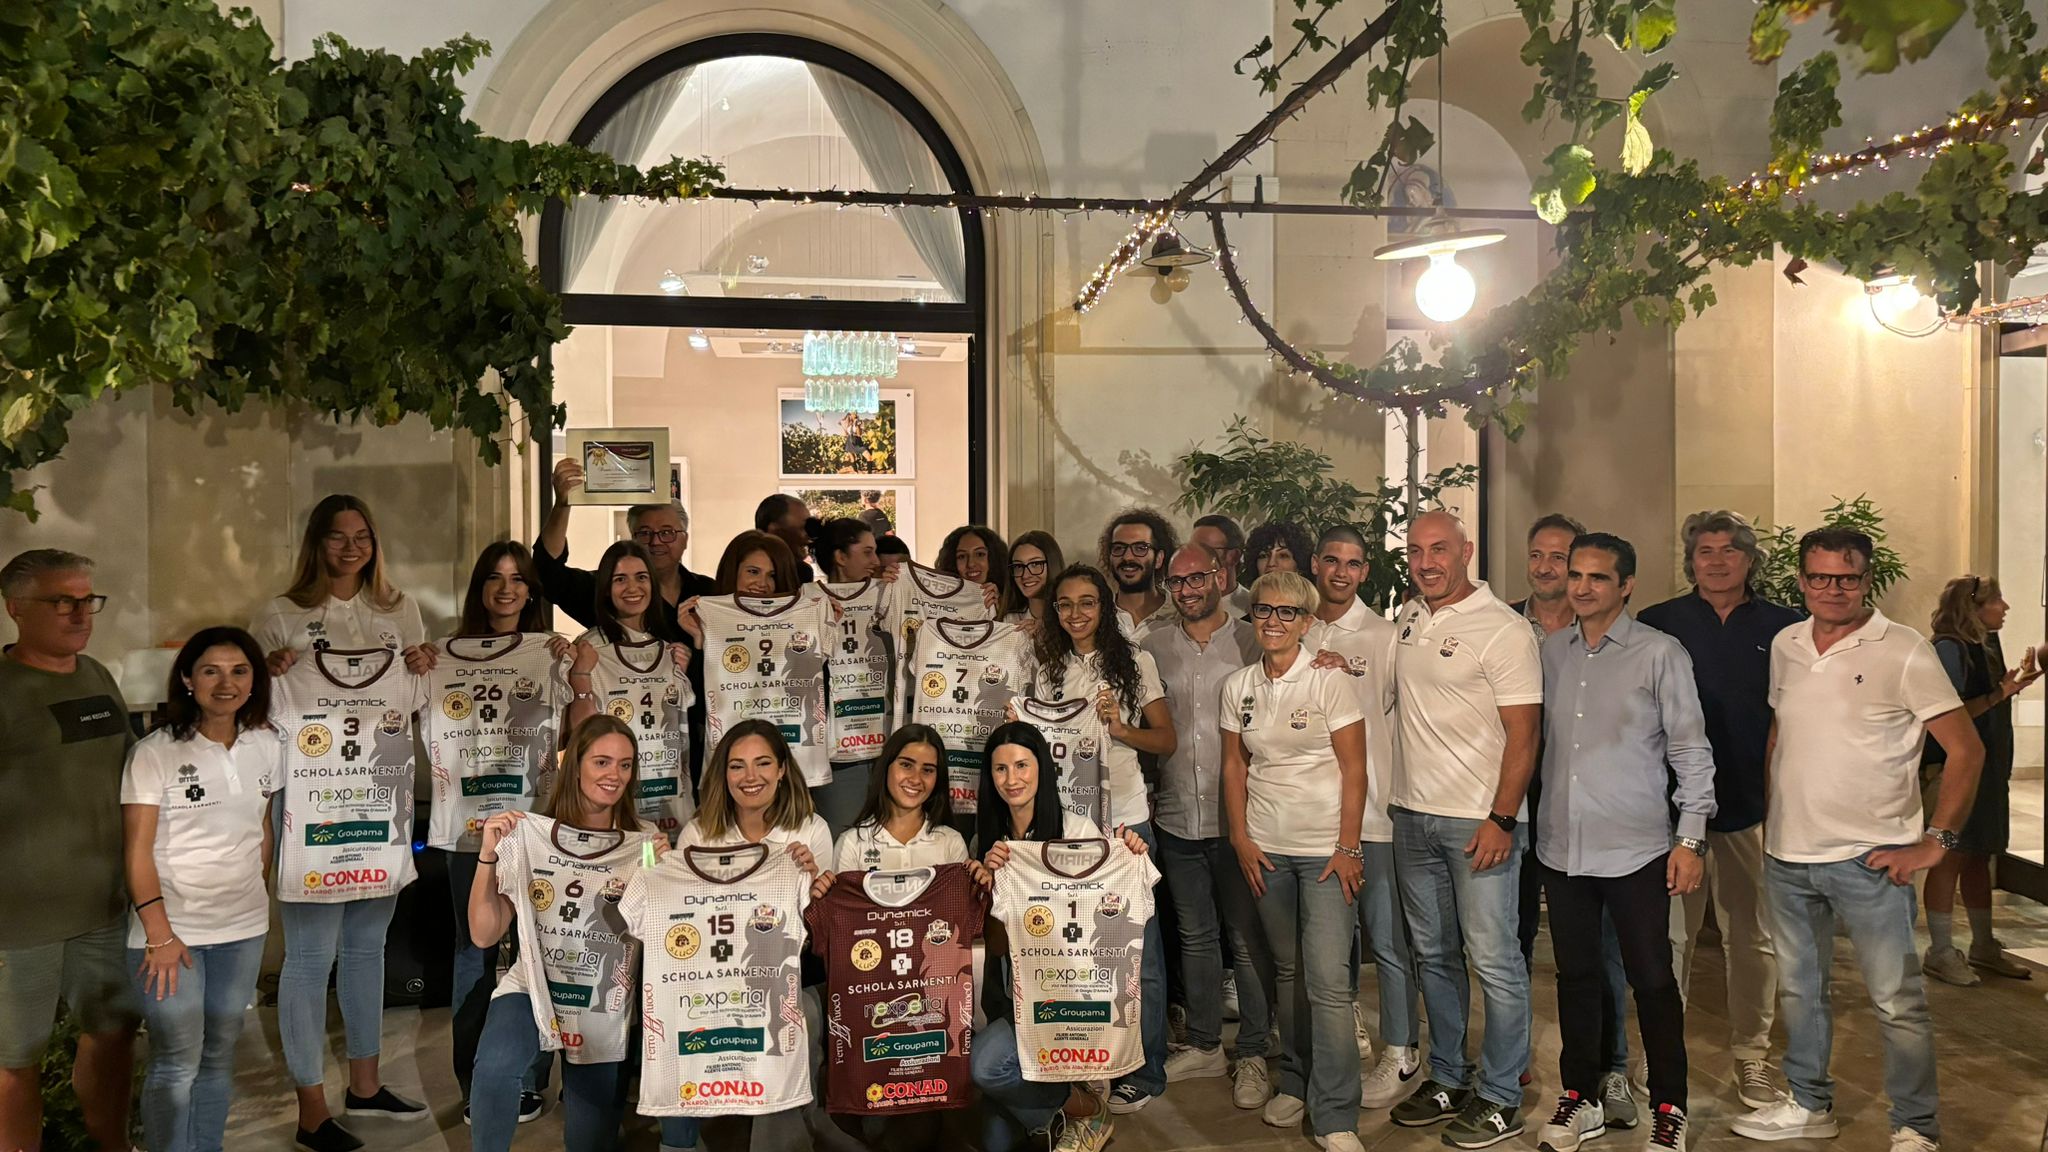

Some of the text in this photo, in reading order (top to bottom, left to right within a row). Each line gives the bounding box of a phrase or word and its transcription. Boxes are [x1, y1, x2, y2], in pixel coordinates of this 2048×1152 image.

[911, 597, 959, 614] Dynamick
[736, 622, 794, 632] Dynamick
[841, 619, 856, 635] 11
[725, 647, 748, 657] CORTE
[759, 639, 773, 656] 9
[937, 651, 989, 662] Dynamick
[455, 668, 518, 677] Dynamick
[924, 672, 944, 682] CORTE
[956, 669, 968, 684] 7
[619, 676, 667, 685] Dynamick
[720, 679, 814, 691] SCHOLA SARMENTI
[445, 693, 468, 704] CORTE
[473, 684, 503, 701] 26
[317, 698, 387, 708] Dynamick
[608, 699, 632, 710] CORTE
[640, 692, 653, 708] 4
[733, 693, 800, 711] nexperia
[845, 704, 881, 713] Groupama
[918, 706, 1004, 718] SCHOLA SARMENTI
[301, 726, 329, 738] CORTE
[343, 717, 360, 736] 3
[443, 727, 539, 740] SCHOLA SARMENTI
[644, 731, 680, 740] SARMEN
[841, 733, 886, 748] CONAD
[459, 742, 524, 759] nexperia
[638, 748, 678, 764] xperia
[293, 766, 406, 778] SCHOLA SARMENTI
[308, 784, 390, 803] nexperia
[1057, 787, 1100, 795] ARMENTI
[337, 828, 383, 839] Groupama
[548, 855, 612, 874] Dynamick
[323, 869, 389, 888] CONAD
[565, 880, 584, 898] 6
[1041, 881, 1105, 891] Dynamick
[684, 892, 758, 905] Dynamick
[867, 908, 933, 921] Dynamick
[1027, 908, 1051, 918] CORTE
[1067, 901, 1077, 918] 1
[707, 914, 735, 936] 15
[560, 928, 620, 944] SARMENTI
[669, 926, 698, 938] CORTE
[886, 928, 914, 949] 18
[853, 941, 879, 952] CORTE
[1020, 947, 1127, 958] SCHOLA SARMENTI
[544, 947, 600, 966] xperia
[661, 967, 780, 983] SCHOLA SARMENTI
[1034, 964, 1111, 984] nexperia
[848, 976, 957, 994] SCHOLA SARMENTI
[551, 990, 585, 1001] oupama
[679, 987, 763, 1010] nexperia
[863, 994, 942, 1018] nexperia
[1059, 1008, 1105, 1017] Groupama
[710, 1036, 758, 1046] Groupama
[893, 1040, 940, 1051] Groupama
[900, 1056, 940, 1066] Assicurazioni
[1049, 1048, 1111, 1063] CONAD
[698, 1080, 764, 1098] CONAD
[883, 1079, 948, 1099] CONAD
